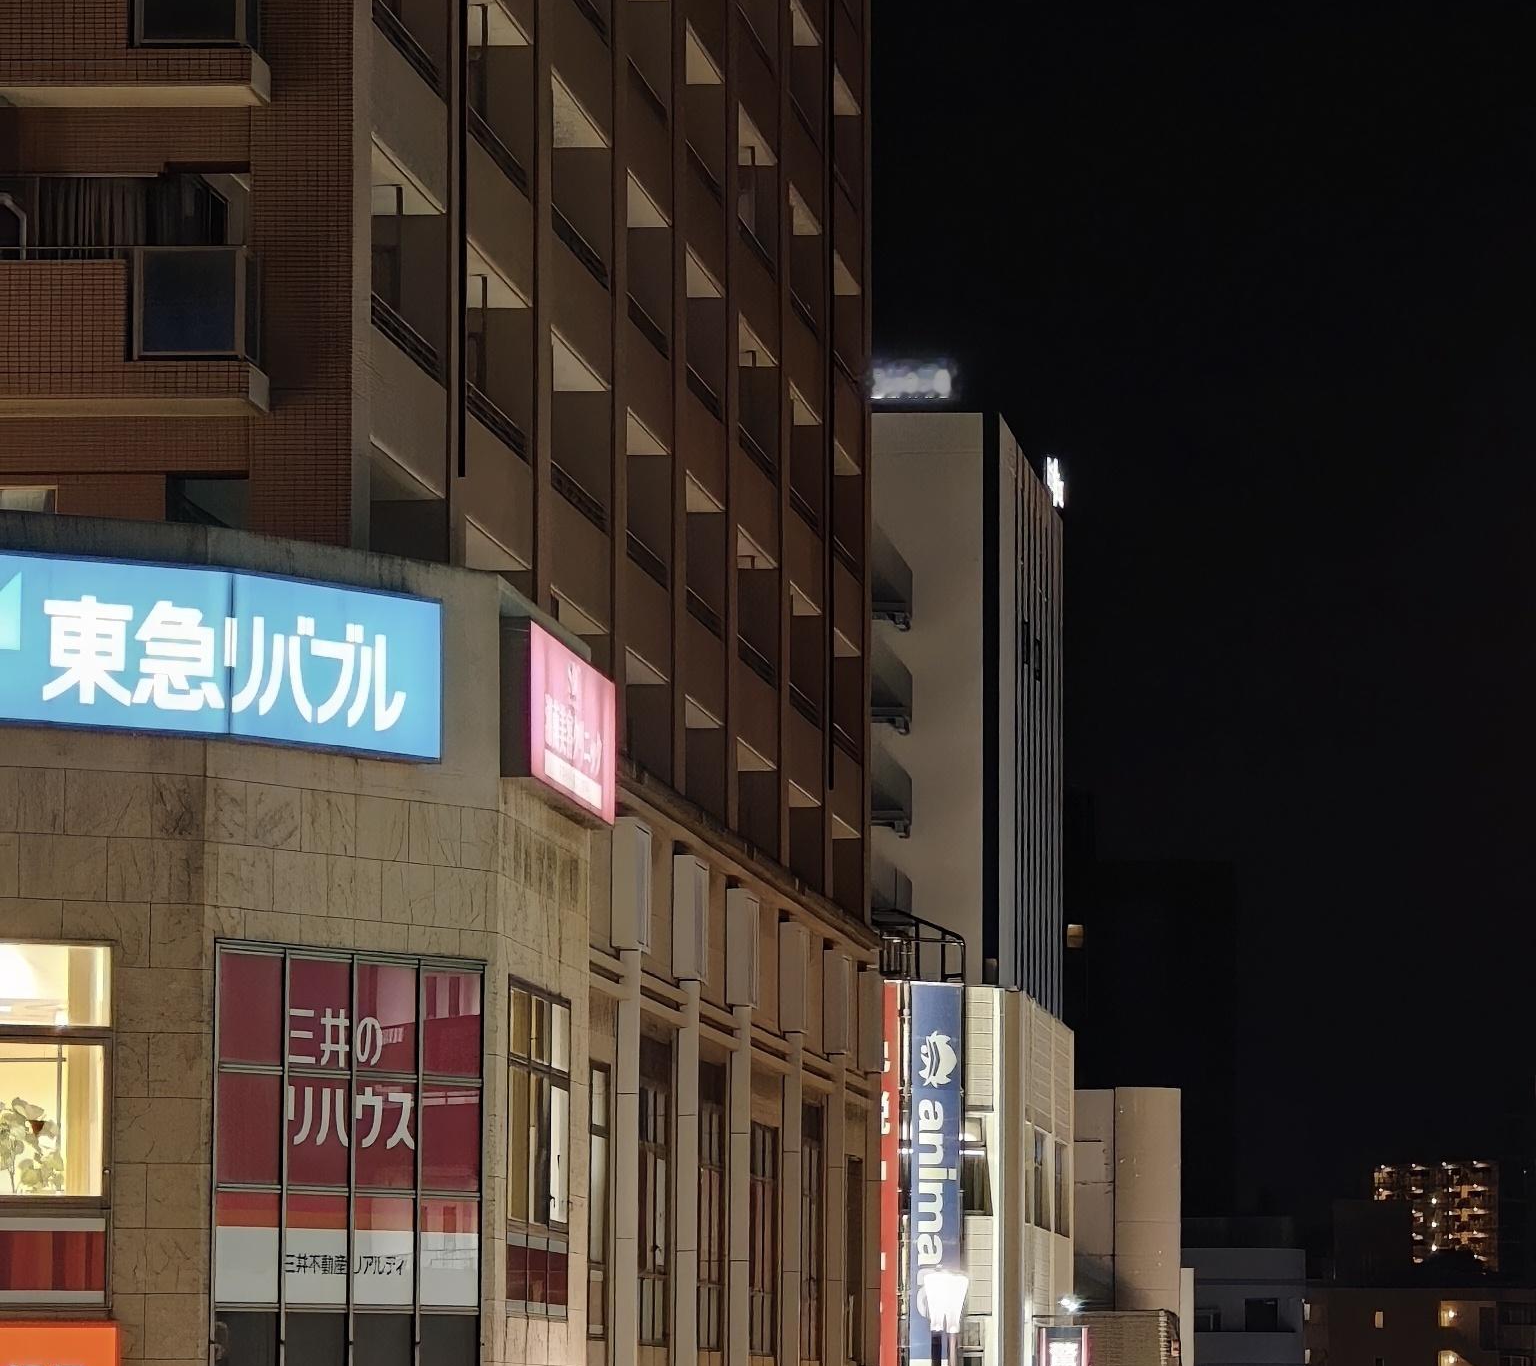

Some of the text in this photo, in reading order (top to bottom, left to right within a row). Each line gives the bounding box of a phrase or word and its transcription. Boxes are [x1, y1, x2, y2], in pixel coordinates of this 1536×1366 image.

[42, 594, 407, 733] 東急リバブル
[288, 1007, 383, 1068] 三井の
[288, 1086, 416, 1151] リハウス
[918, 1099, 958, 1319] anima
